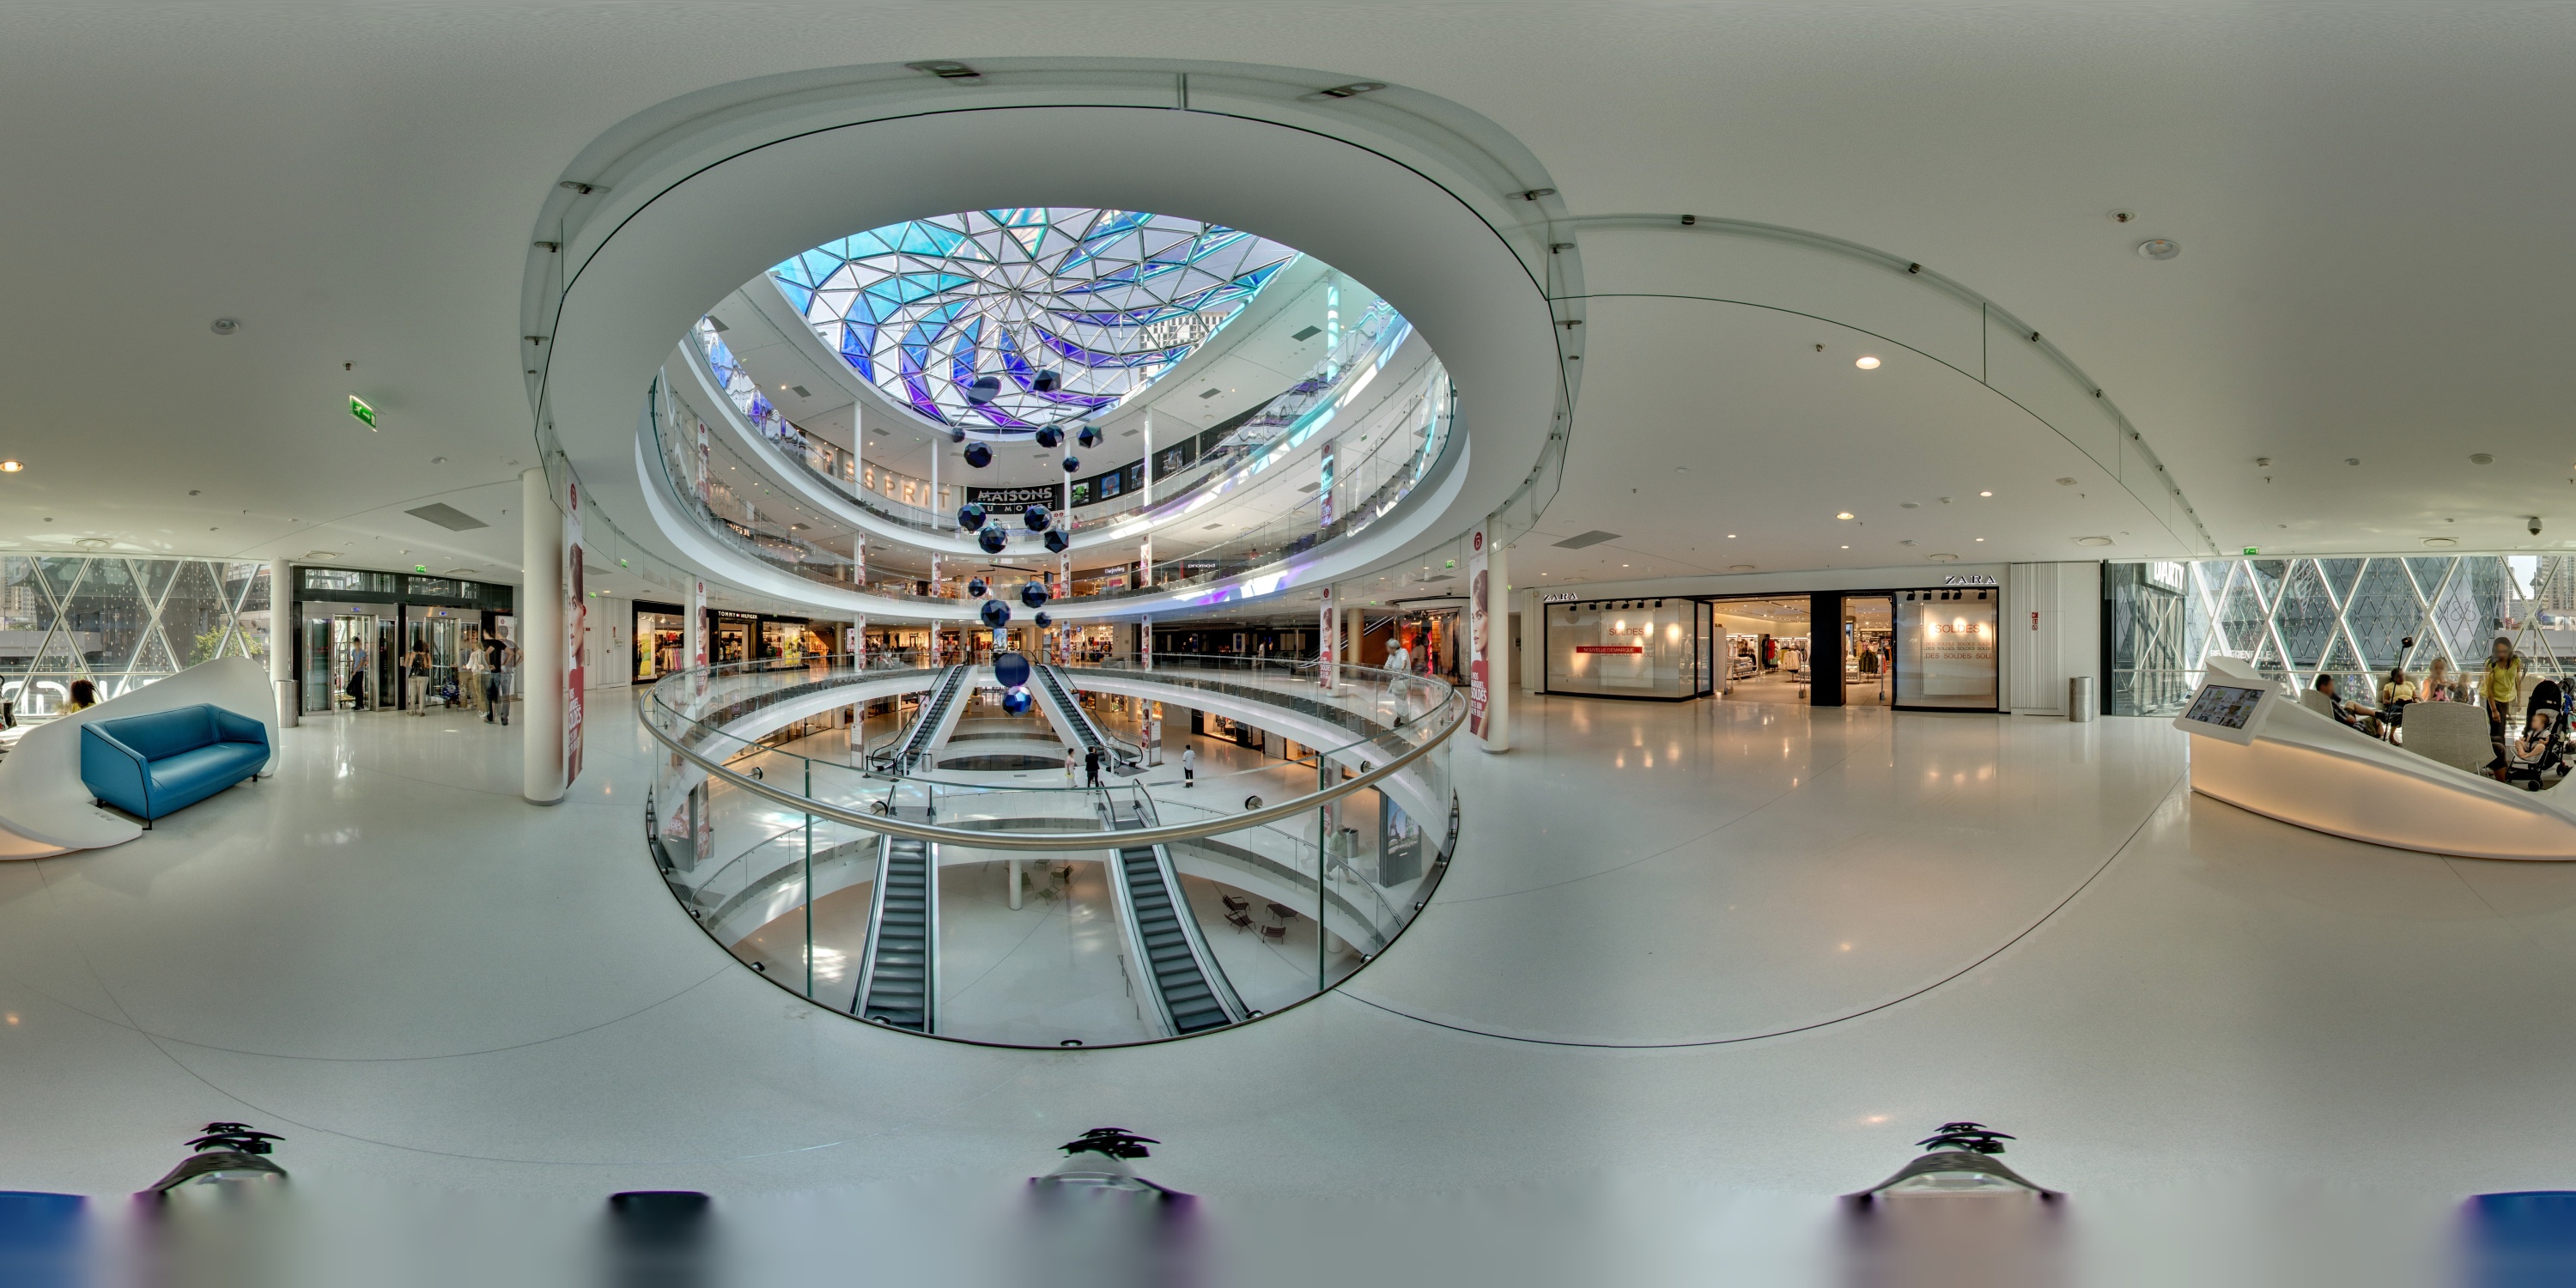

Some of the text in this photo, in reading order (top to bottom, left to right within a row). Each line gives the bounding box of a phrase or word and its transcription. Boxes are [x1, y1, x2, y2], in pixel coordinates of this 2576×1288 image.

[846, 463, 951, 508] ESPRIT
[977, 487, 1053, 501] MAISONS
[1005, 502, 1052, 513] MONE
[1945, 574, 1997, 586] ZARA
[1544, 592, 1578, 601] ZARA
[1935, 624, 1980, 633] SOLDES
[1471, 687, 1487, 702] SOLDES
